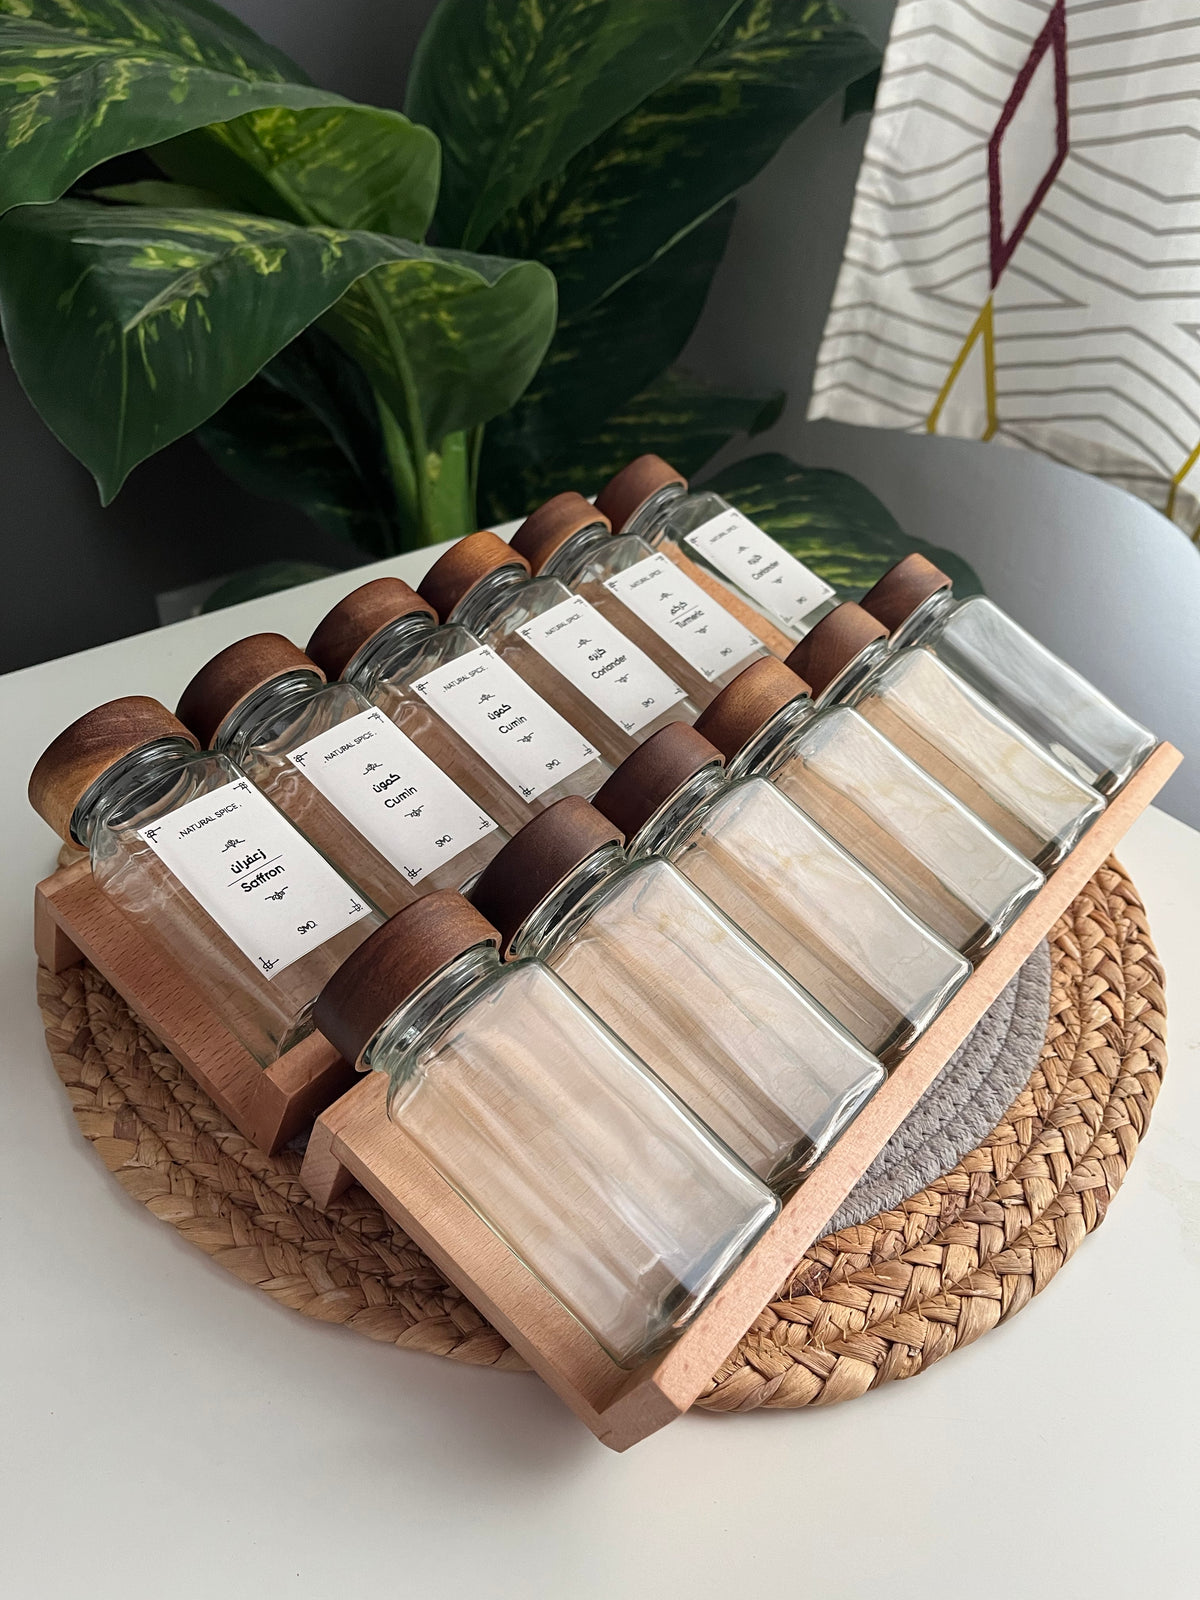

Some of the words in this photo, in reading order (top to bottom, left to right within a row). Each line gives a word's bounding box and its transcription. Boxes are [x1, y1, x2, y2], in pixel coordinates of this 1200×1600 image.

[591, 654, 627, 679] Coriander
[487, 703, 512, 721] كمون
[498, 715, 528, 734] Cumin
[372, 773, 401, 794] كمون
[384, 785, 418, 809] Cumin
[230, 848, 267, 875] زعفران
[240, 864, 286, 893] Saffron
